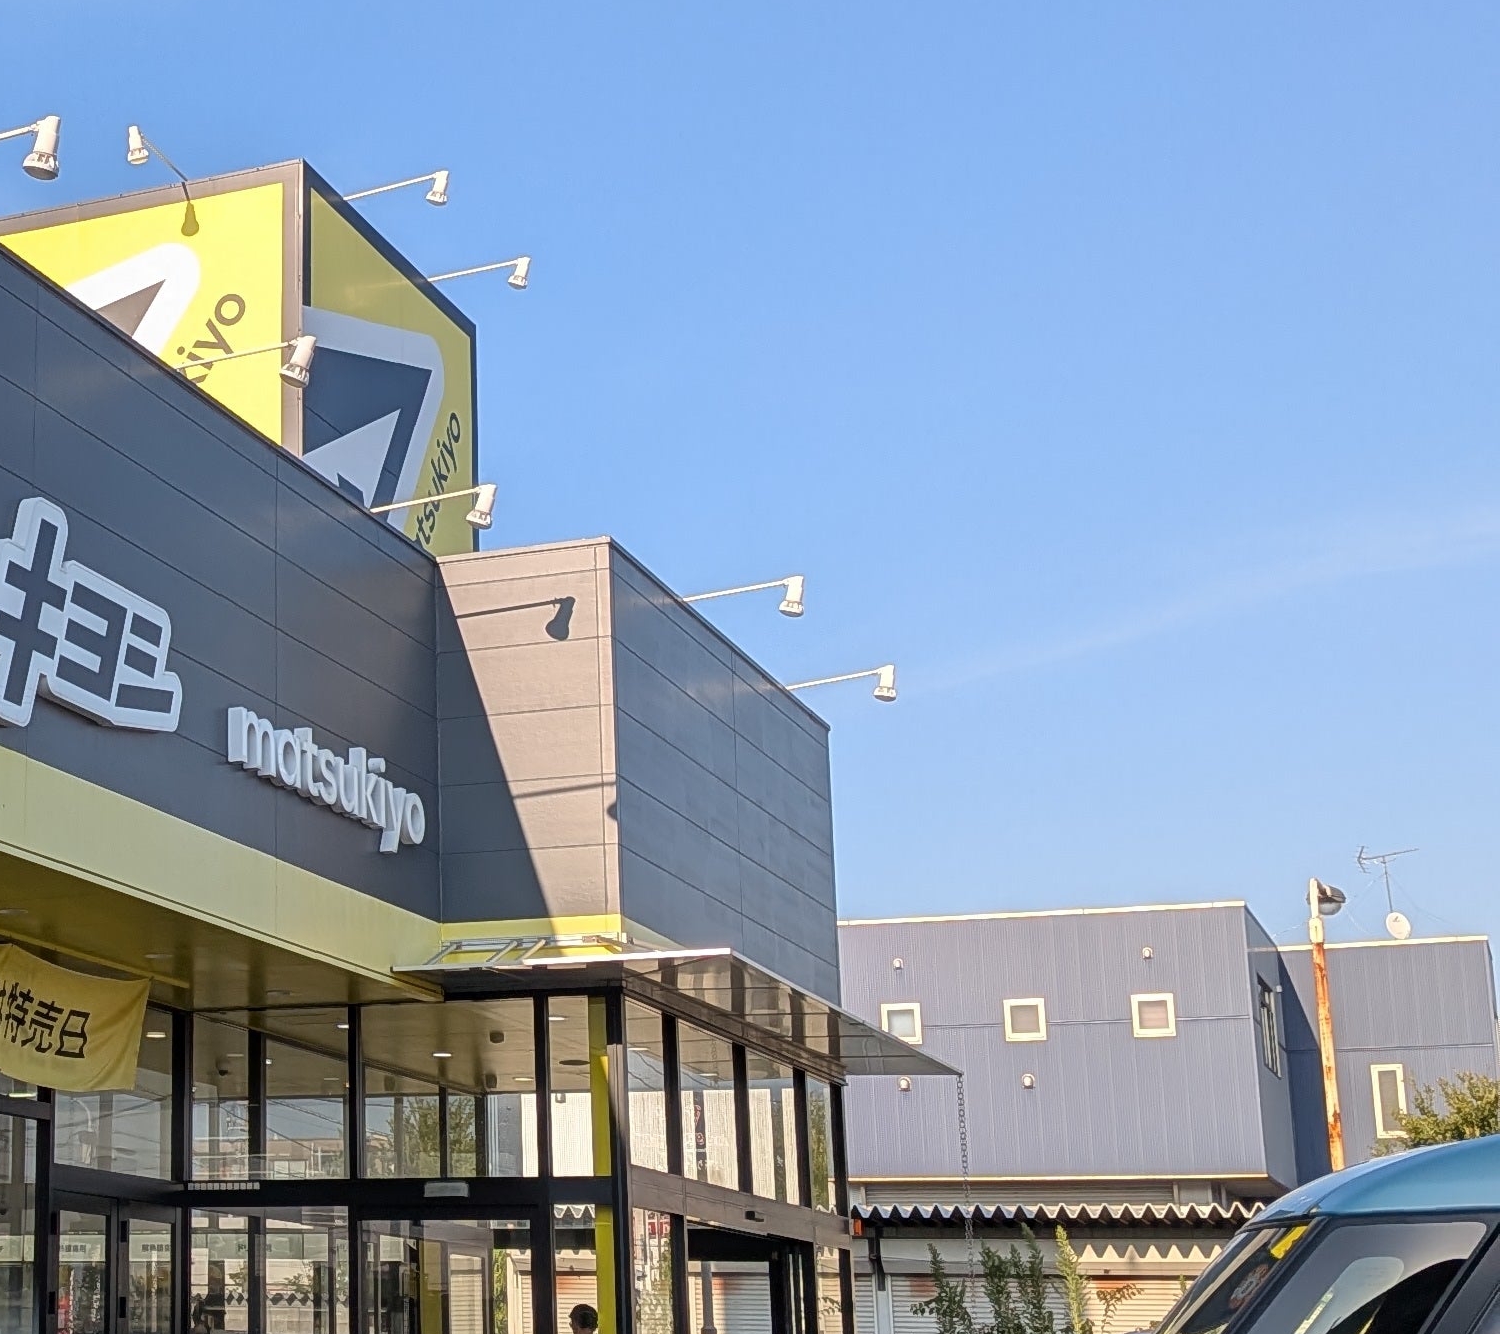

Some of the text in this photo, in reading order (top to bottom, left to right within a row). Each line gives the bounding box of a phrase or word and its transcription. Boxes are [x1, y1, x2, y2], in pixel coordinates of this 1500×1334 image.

[180, 293, 246, 384] iyo
[413, 412, 462, 546] tsukiyo
[228, 706, 426, 854] matsukiyo
